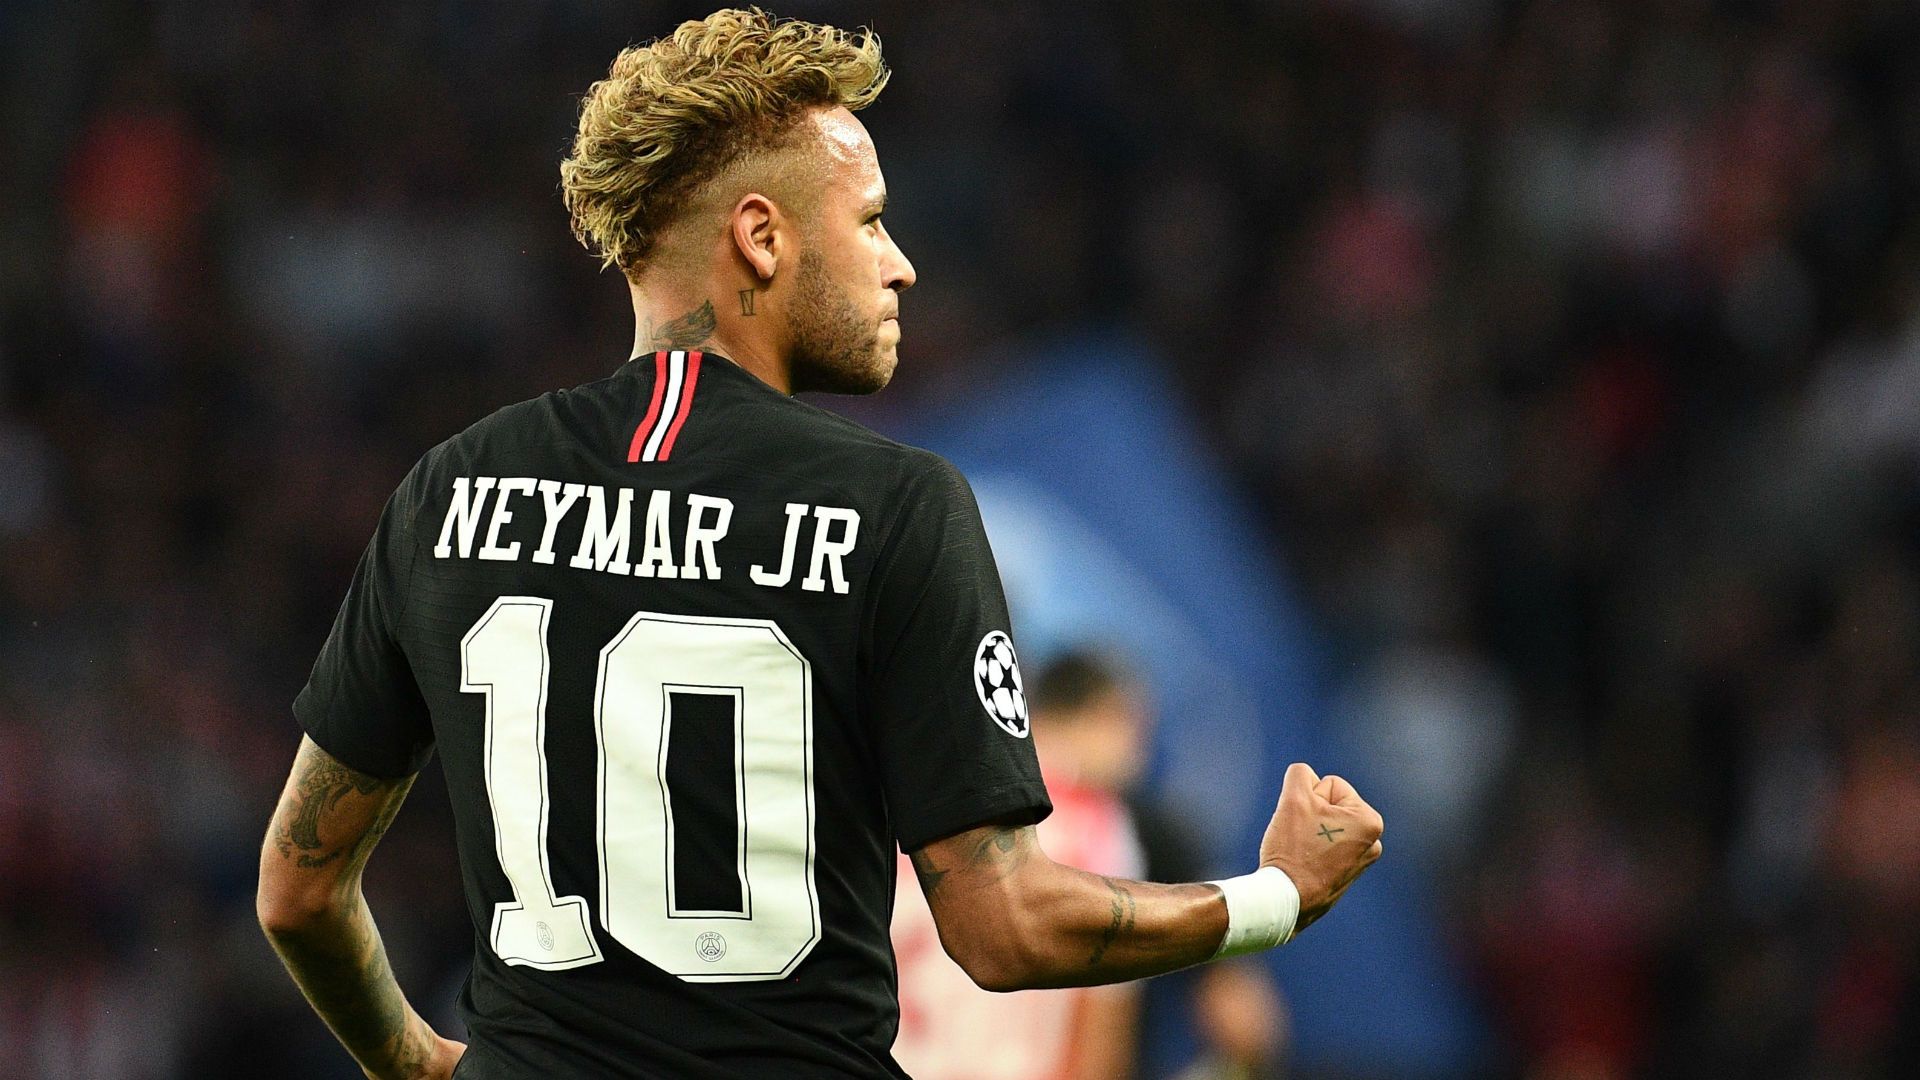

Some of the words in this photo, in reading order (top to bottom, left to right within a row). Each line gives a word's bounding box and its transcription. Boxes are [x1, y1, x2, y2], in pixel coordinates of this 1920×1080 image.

[434, 477, 734, 580] NEYMAR
[750, 503, 861, 595] JR
[460, 596, 822, 983] 10
